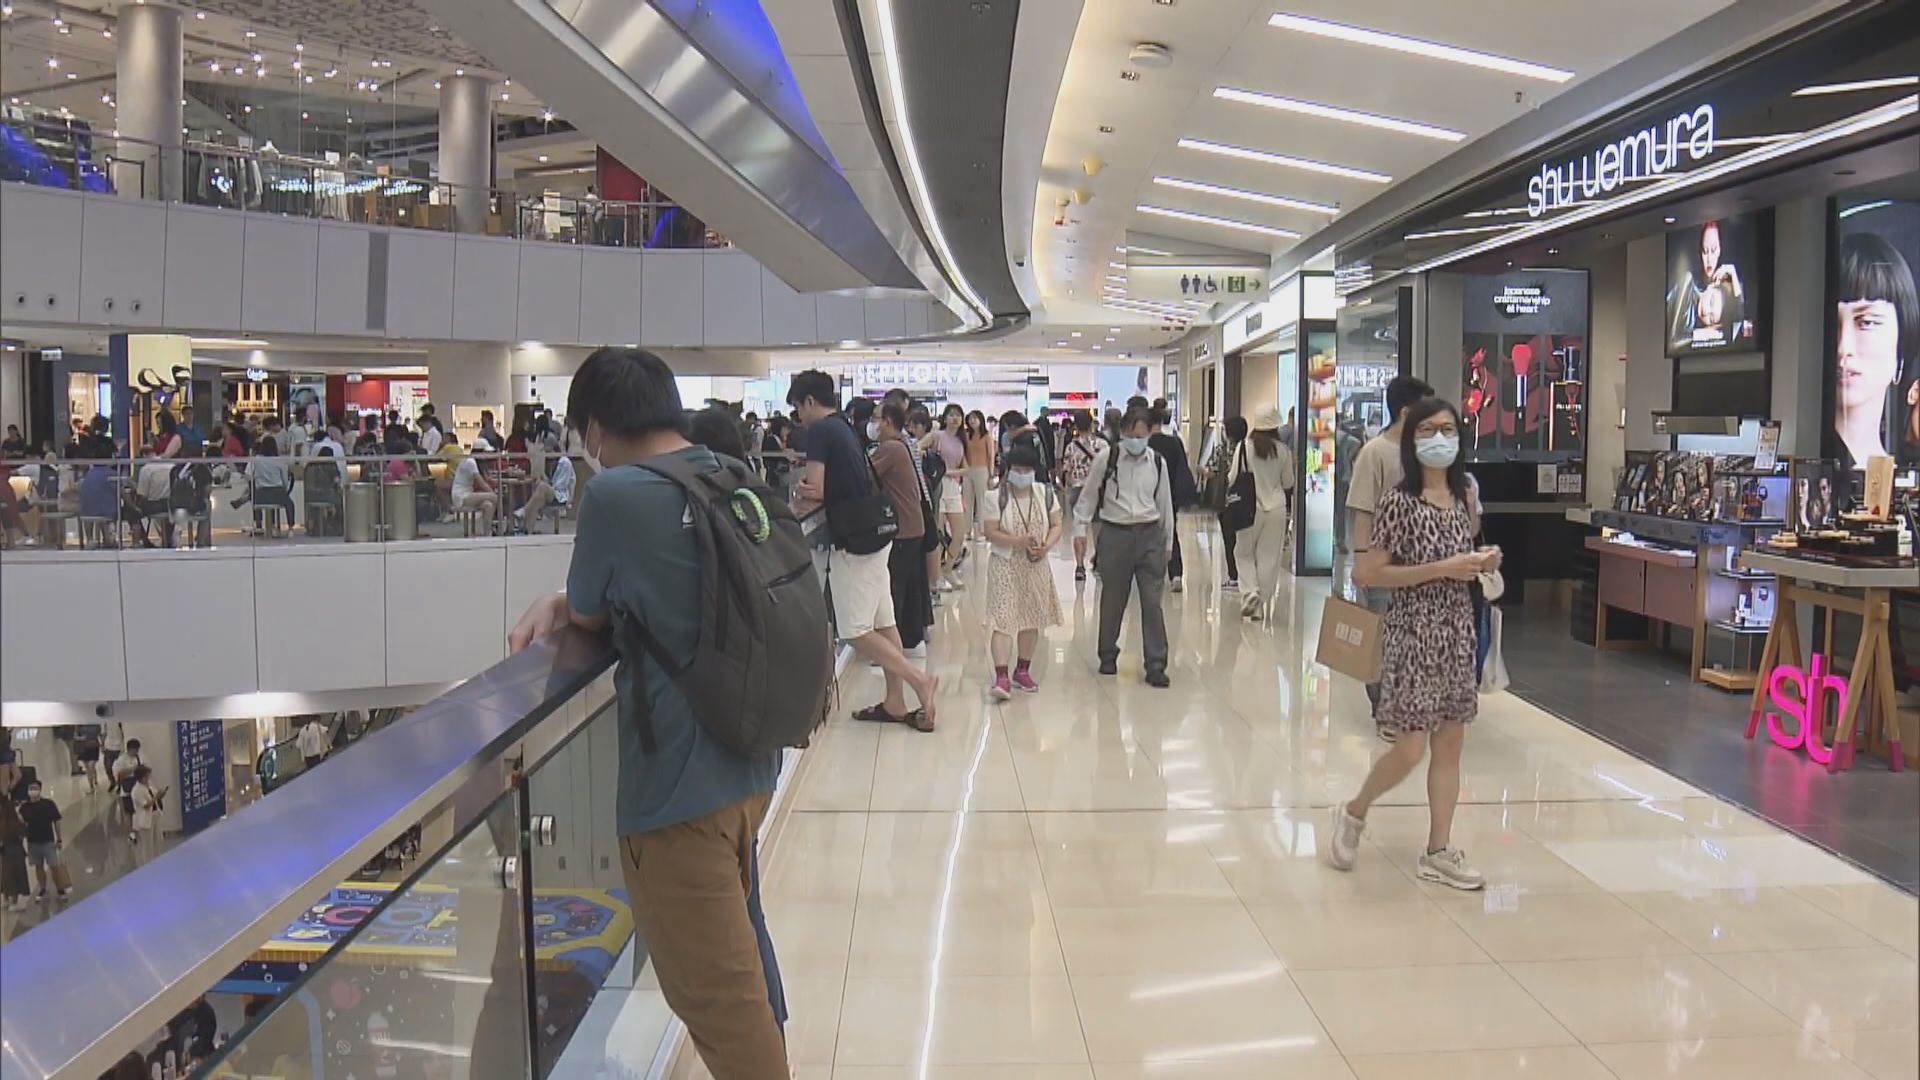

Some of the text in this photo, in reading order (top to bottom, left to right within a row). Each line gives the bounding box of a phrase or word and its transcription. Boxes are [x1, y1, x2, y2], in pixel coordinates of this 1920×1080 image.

[1528, 104, 1714, 217] shu uemura
[857, 363, 976, 385] SEPHORA
